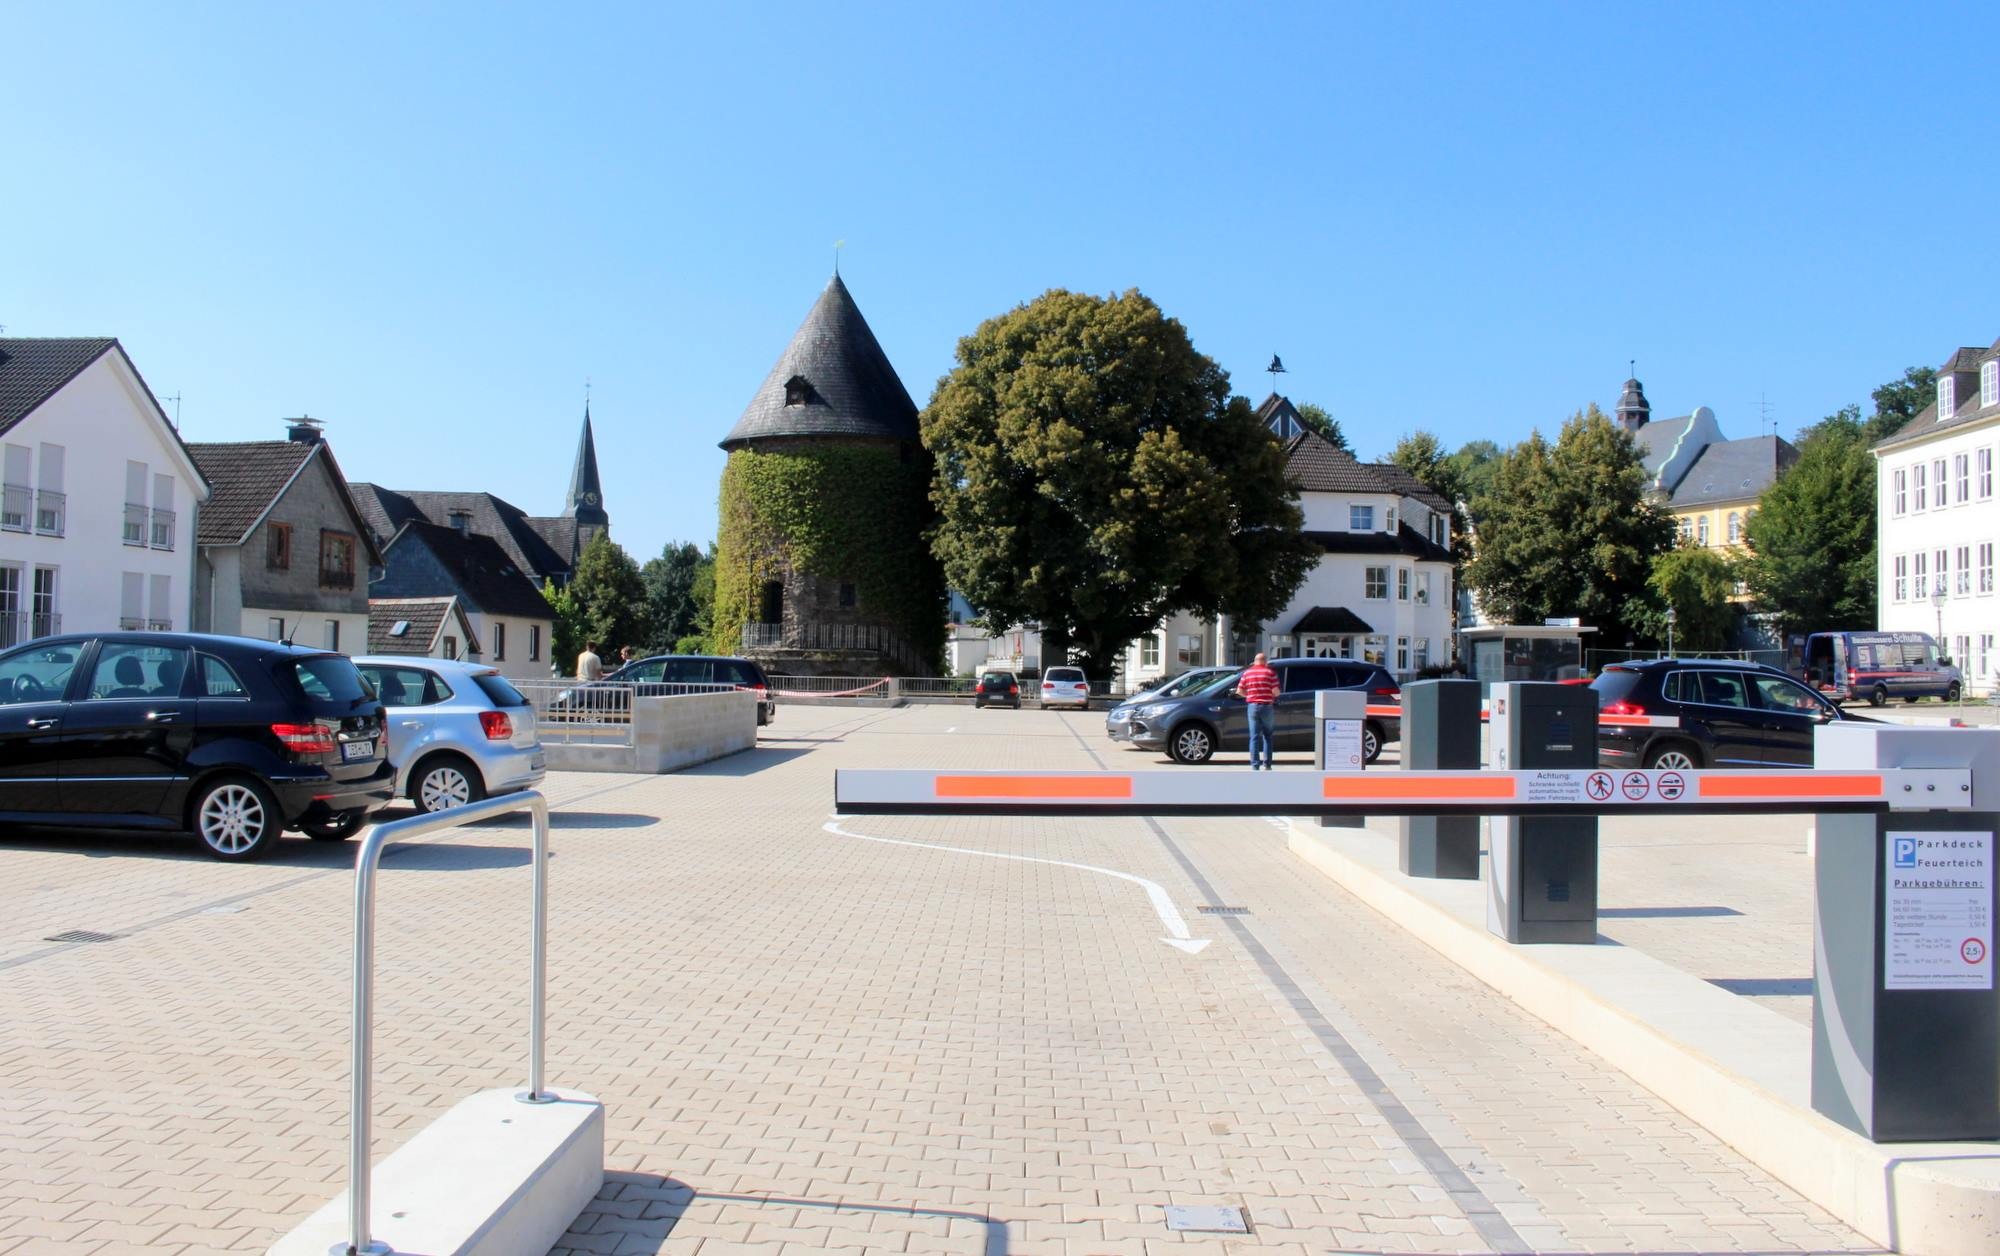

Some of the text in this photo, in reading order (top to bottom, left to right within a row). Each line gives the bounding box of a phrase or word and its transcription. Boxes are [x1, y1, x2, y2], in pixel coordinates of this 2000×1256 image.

[1893, 633, 1923, 644] Schulte
[1917, 840, 1983, 849] Parkdeck
[1897, 840, 1914, 862] P
[1917, 859, 1983, 868] Feuerteich
[1894, 878, 1984, 889] Parkgebühren:
